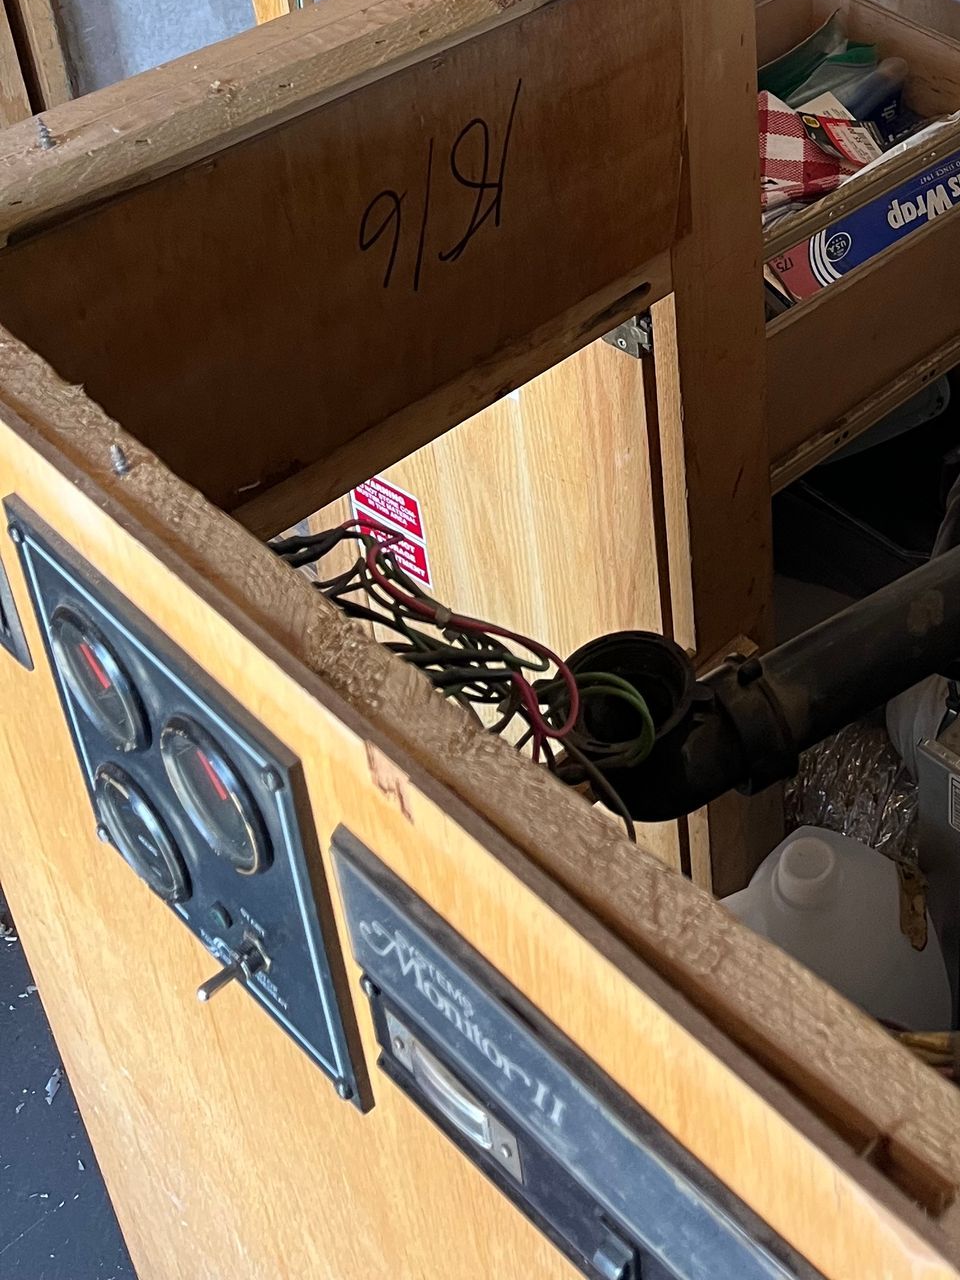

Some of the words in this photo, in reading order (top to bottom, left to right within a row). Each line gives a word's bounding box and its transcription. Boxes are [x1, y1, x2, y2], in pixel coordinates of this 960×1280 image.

[937, 163, 955, 178] SINCE
[887, 185, 953, 229] Wrap
[828, 240, 847, 252] USA
[776, 257, 793, 273] 175
[359, 920, 532, 1085] Monitor
[532, 1079, 568, 1126] II
